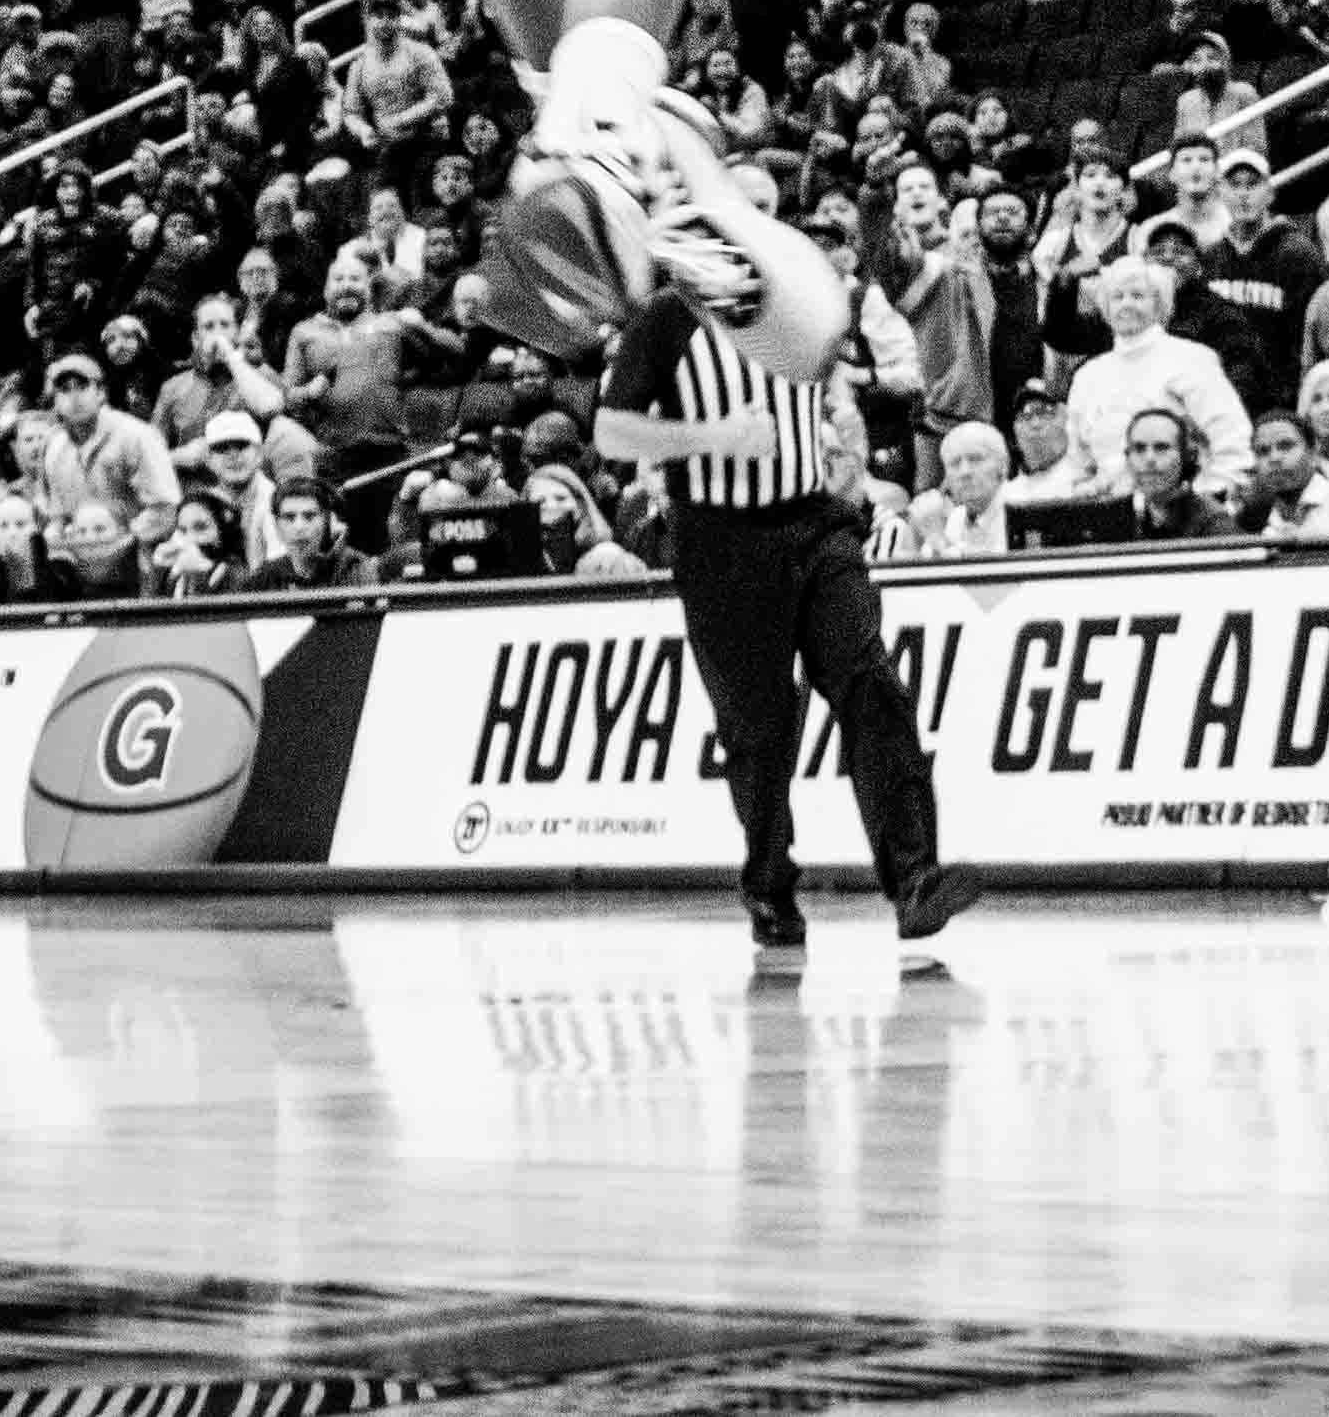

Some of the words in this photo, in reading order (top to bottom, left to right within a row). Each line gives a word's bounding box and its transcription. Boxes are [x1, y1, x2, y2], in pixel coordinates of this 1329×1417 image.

[100, 679, 179, 791] G
[469, 636, 685, 784] HOYA
[991, 612, 1182, 773] GET
[1184, 609, 1253, 770] A
